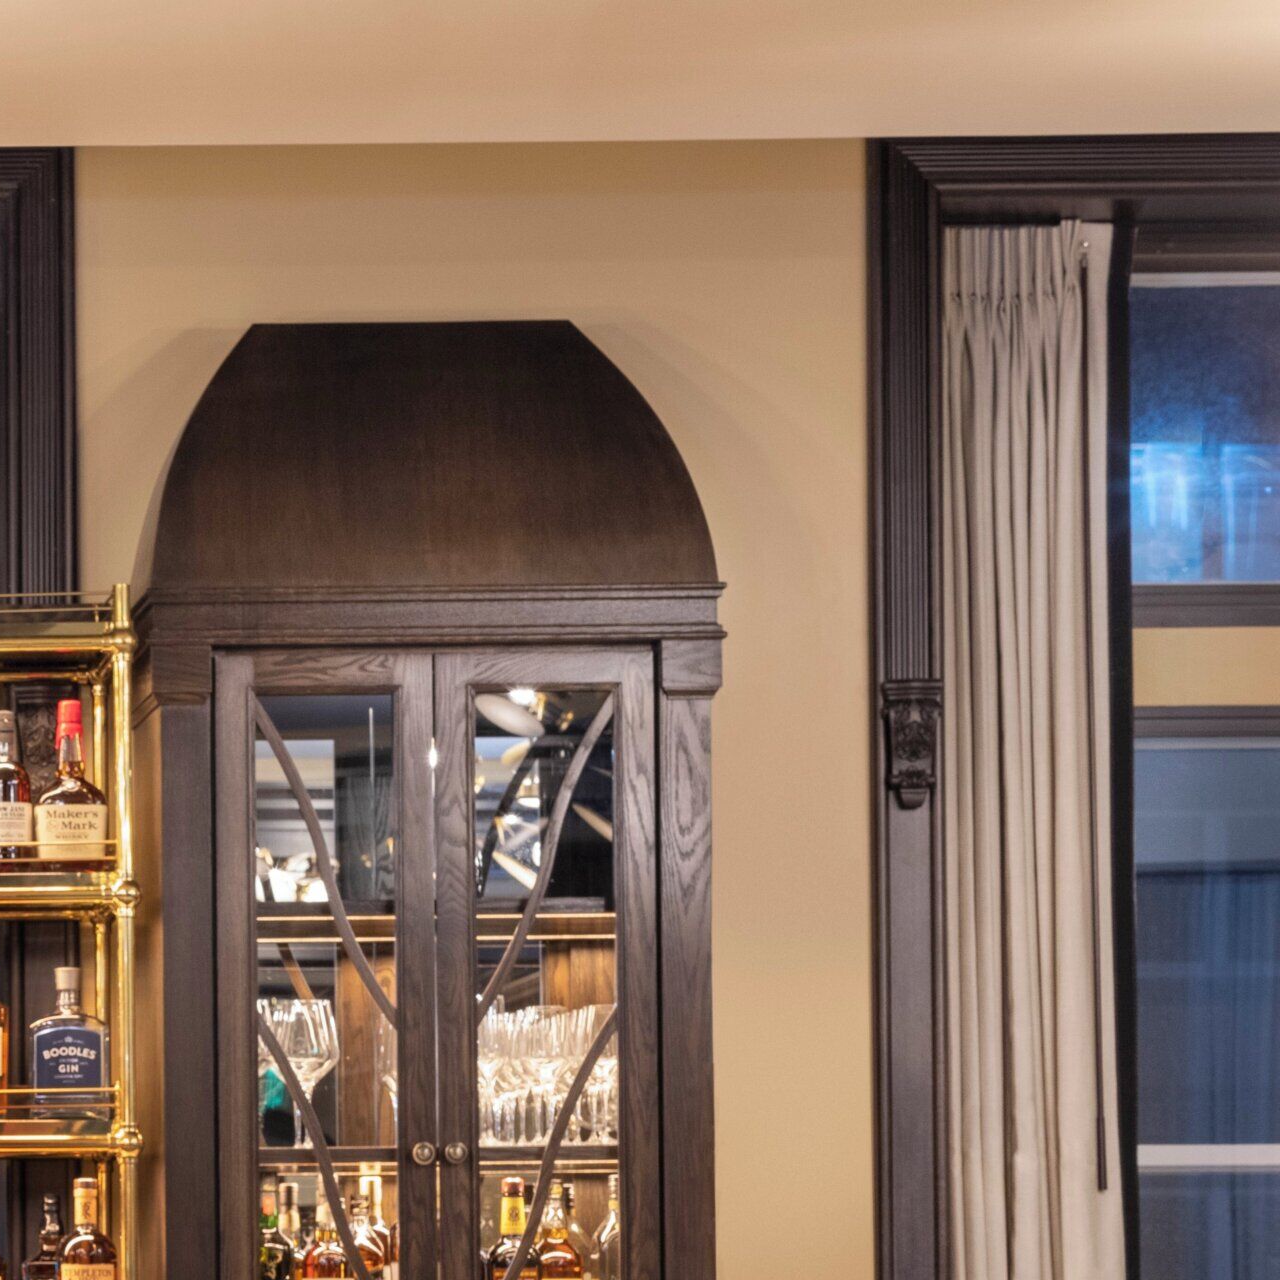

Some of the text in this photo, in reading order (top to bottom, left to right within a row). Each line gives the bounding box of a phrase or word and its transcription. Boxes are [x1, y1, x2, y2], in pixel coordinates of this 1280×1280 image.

[46, 809, 99, 819] Maker's
[61, 820, 98, 830] Mark
[42, 1046, 97, 1060] BOODLES
[57, 1063, 80, 1073] GIN
[64, 1268, 112, 1276] TEMPLETON
